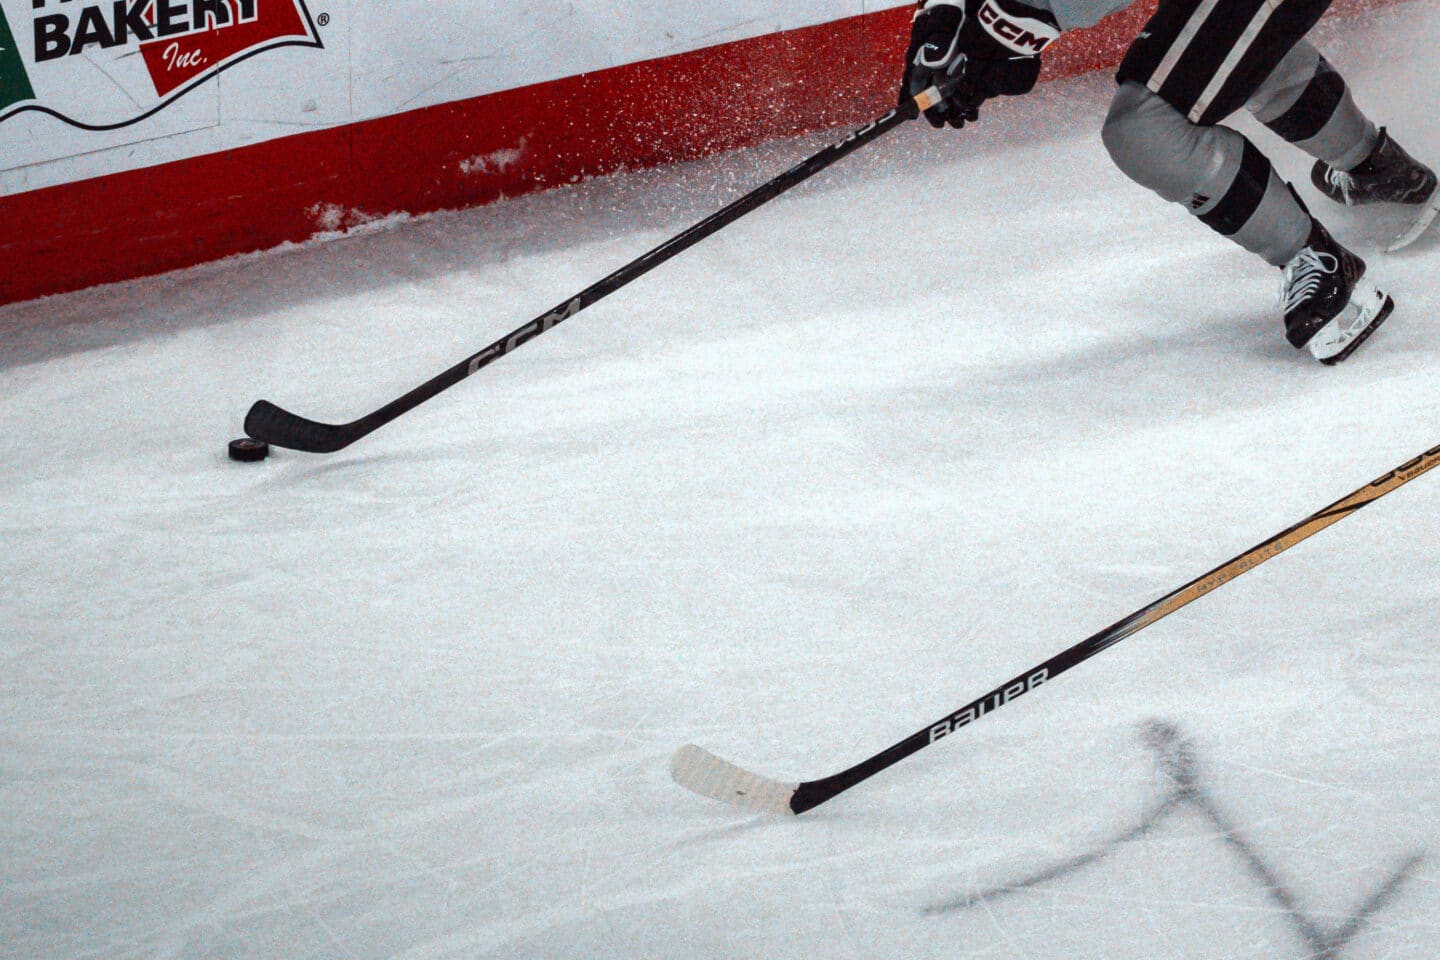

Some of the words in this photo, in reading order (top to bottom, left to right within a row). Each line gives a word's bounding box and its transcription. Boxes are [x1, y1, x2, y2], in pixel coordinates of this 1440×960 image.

[980, 3, 1051, 53] CCM
[162, 42, 208, 72] Inc.
[929, 667, 1049, 745] BAUER
